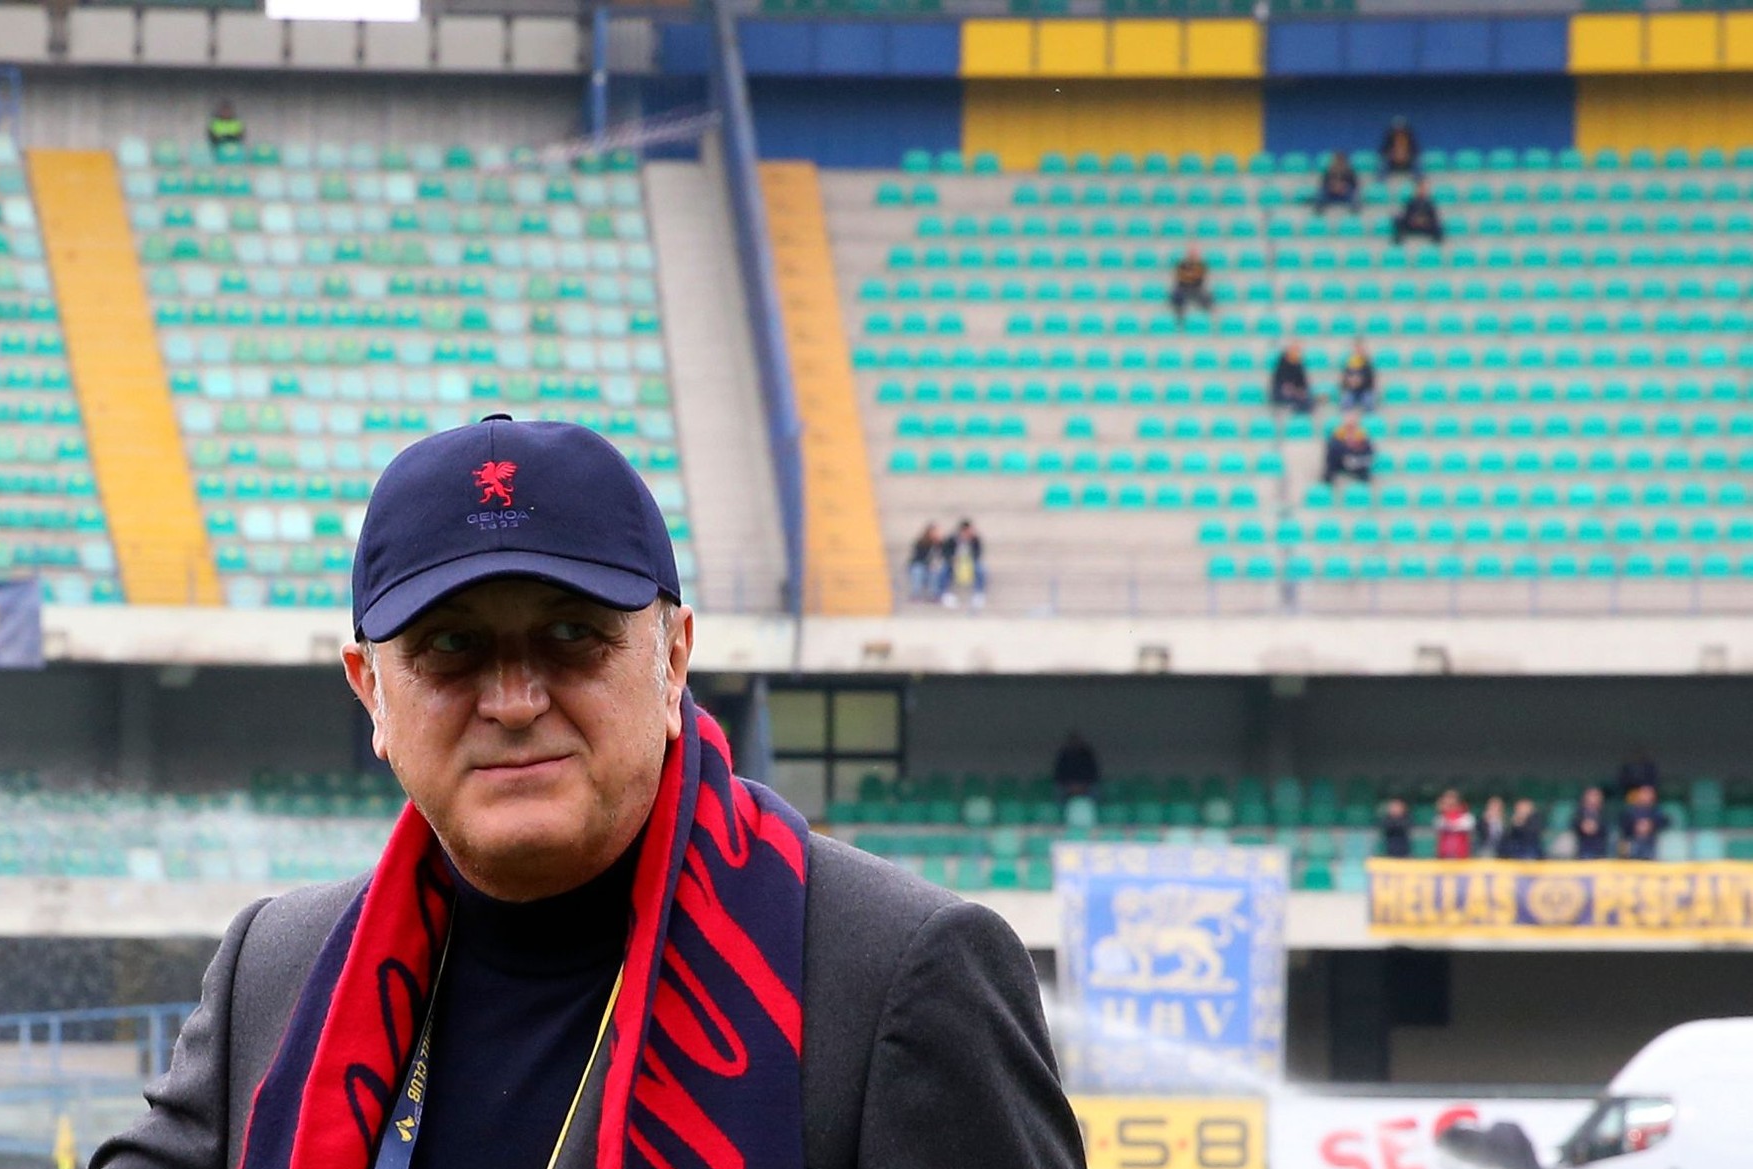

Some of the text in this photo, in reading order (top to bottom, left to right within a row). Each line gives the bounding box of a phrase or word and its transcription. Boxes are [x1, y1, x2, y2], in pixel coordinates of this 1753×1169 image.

[467, 510, 530, 523] GENOA
[1372, 873, 1514, 926] HELLAS
[407, 1061, 427, 1103] CLUB
